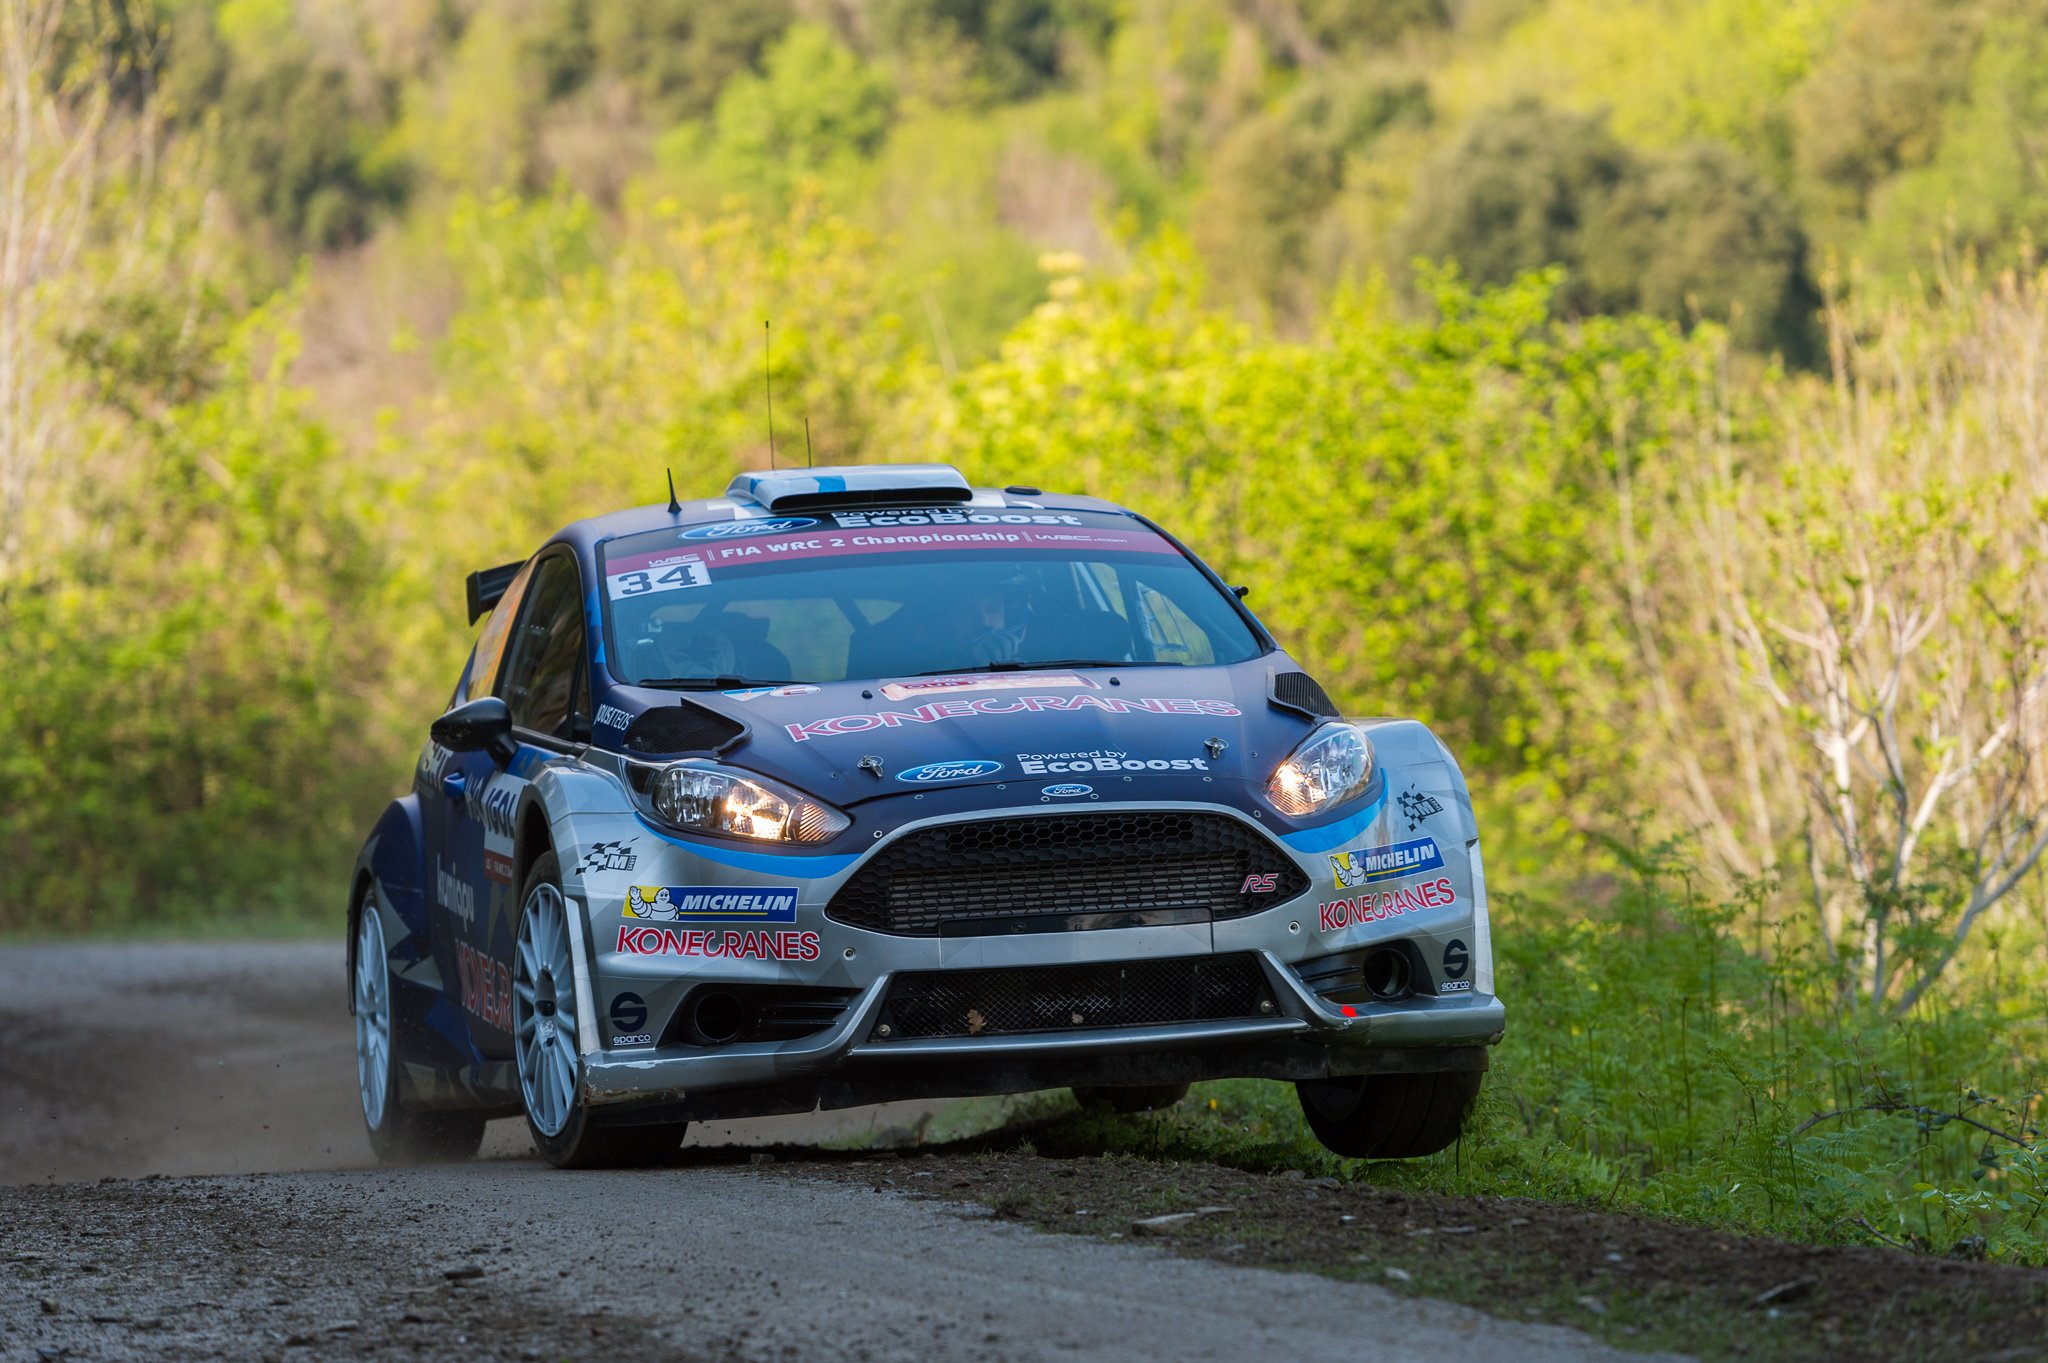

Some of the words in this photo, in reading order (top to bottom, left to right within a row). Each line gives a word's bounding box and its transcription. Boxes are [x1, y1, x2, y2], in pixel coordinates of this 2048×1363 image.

[830, 508, 940, 517] Powered
[834, 513, 1083, 528] EcoBoost
[720, 547, 762, 559] FIA
[766, 539, 823, 553] WRC
[831, 538, 845, 548] 2
[852, 532, 1020, 547] Championship
[618, 564, 698, 595] 34
[784, 694, 1242, 743] KONECRANES
[1016, 750, 1100, 763] Powered
[1103, 749, 1127, 760] by
[916, 762, 984, 780] Ford
[1020, 757, 1209, 776] EcoBoost
[1051, 784, 1082, 795] Ford
[486, 787, 517, 839] IGOL
[1365, 843, 1435, 872] MICHELIN
[1241, 873, 1279, 894] RS
[680, 894, 794, 911] MICHELIN
[1318, 877, 1456, 933] KONECRANES
[615, 925, 821, 962] KONECRANES
[454, 936, 513, 1035] KONECR
[1441, 980, 1470, 991] sparco
[613, 1034, 651, 1045] sparco
